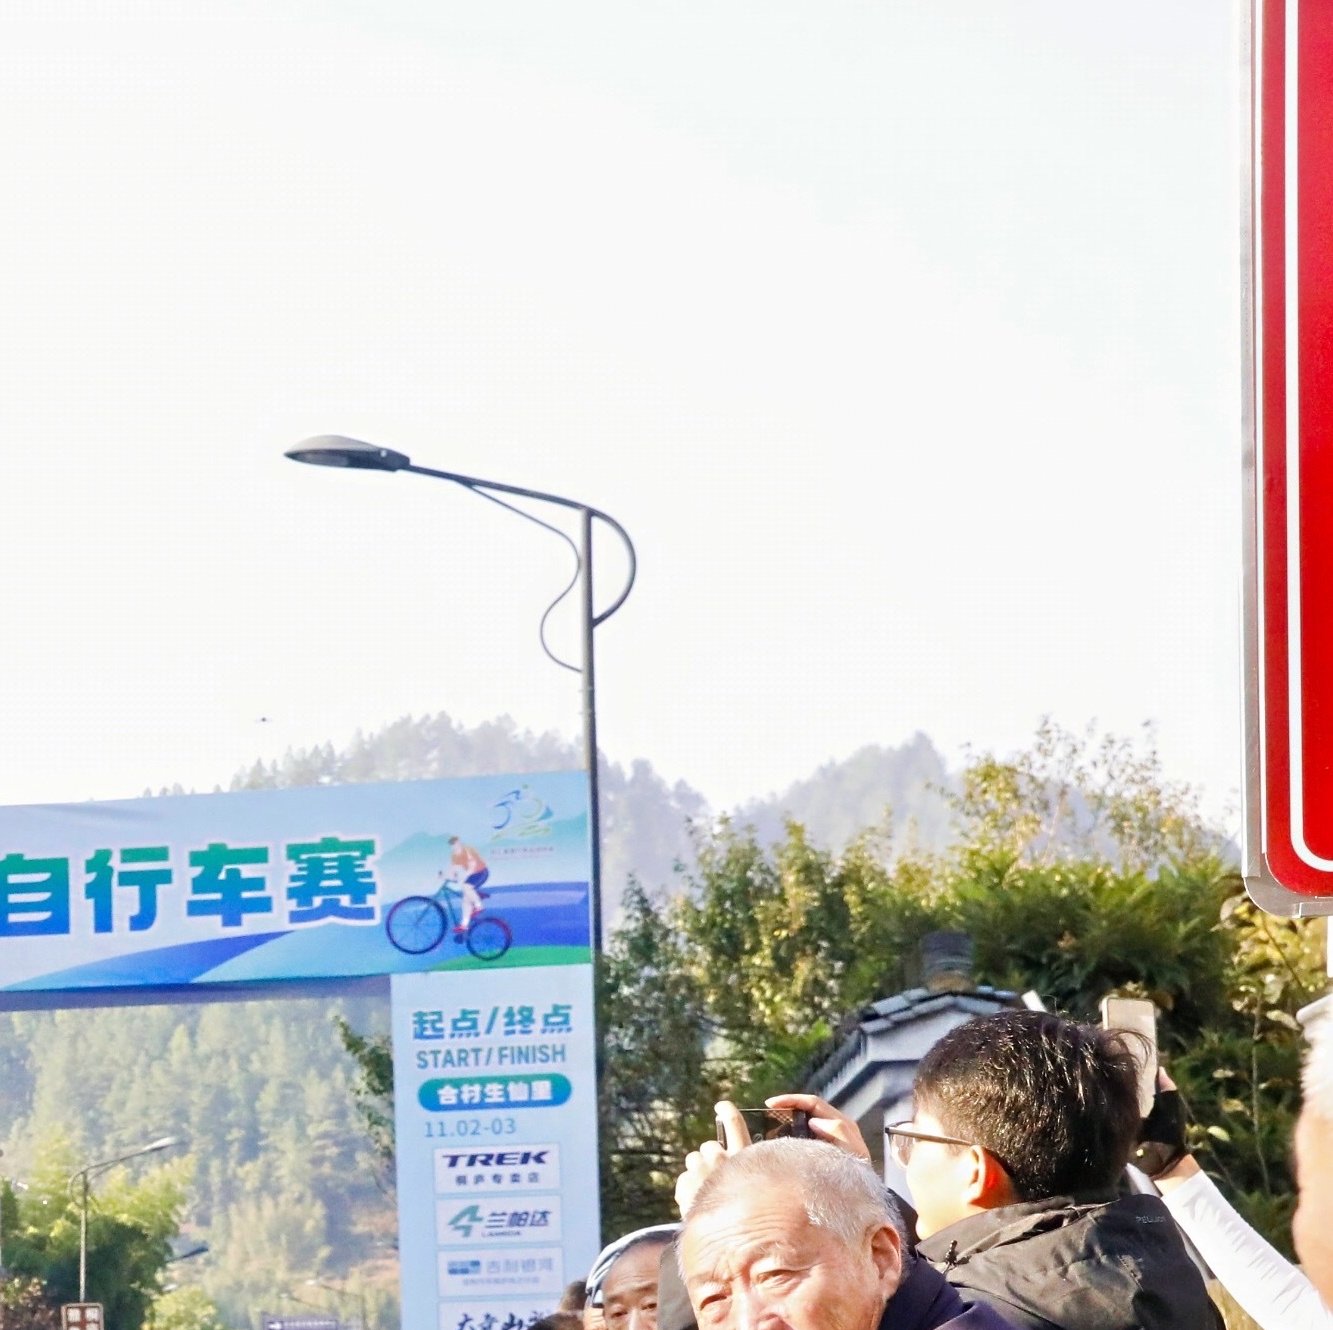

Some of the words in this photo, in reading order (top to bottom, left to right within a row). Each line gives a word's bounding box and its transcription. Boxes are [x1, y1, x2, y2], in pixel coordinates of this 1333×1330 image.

[412, 1004, 573, 1040] 起点/终点
[425, 1118, 517, 1138] 11.02-03
[442, 1151, 551, 1168] TREK
